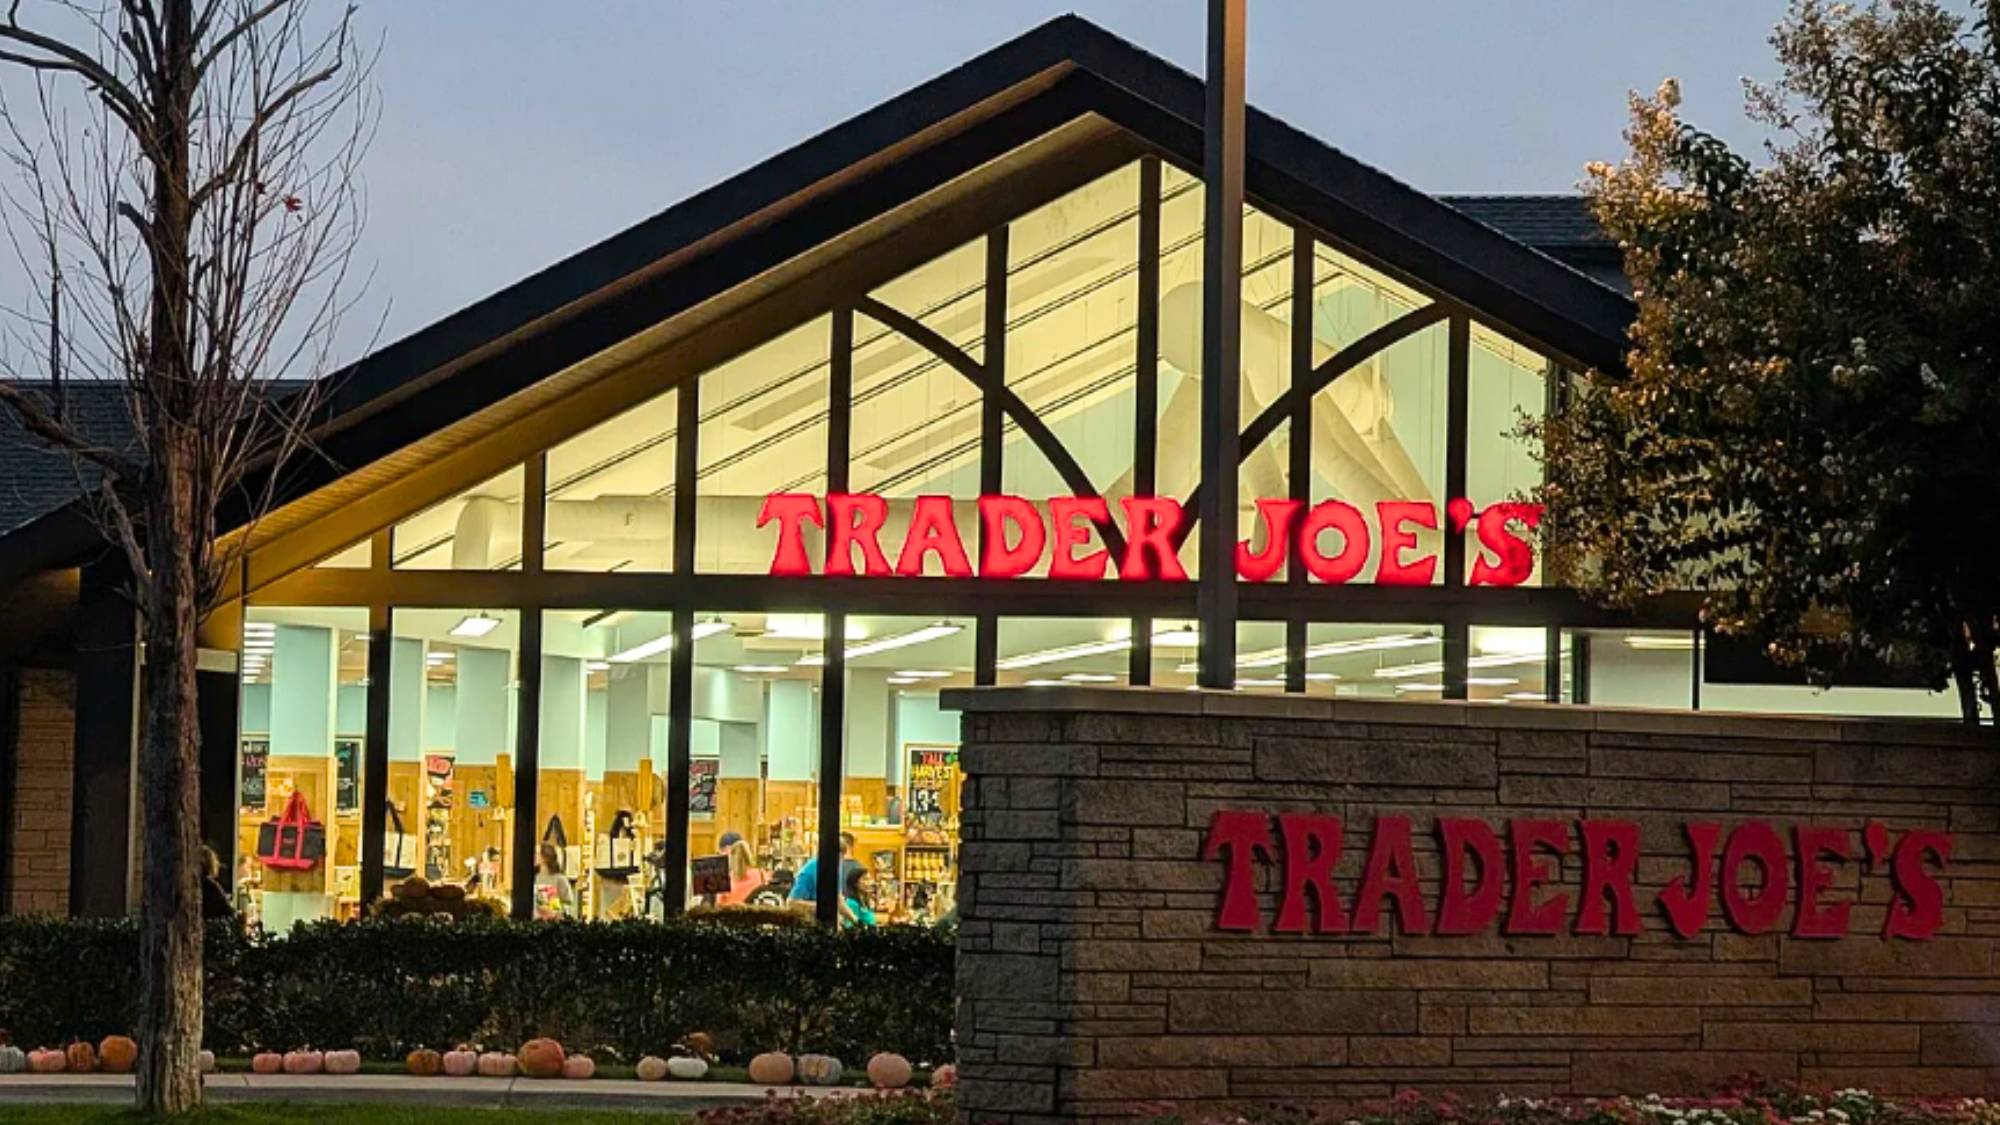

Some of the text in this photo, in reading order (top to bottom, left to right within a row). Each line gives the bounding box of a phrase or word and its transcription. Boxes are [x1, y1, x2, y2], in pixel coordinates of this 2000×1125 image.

[756, 493, 1545, 587] TRADER JOE'S
[1204, 811, 1953, 940] TRADER JOE'S
